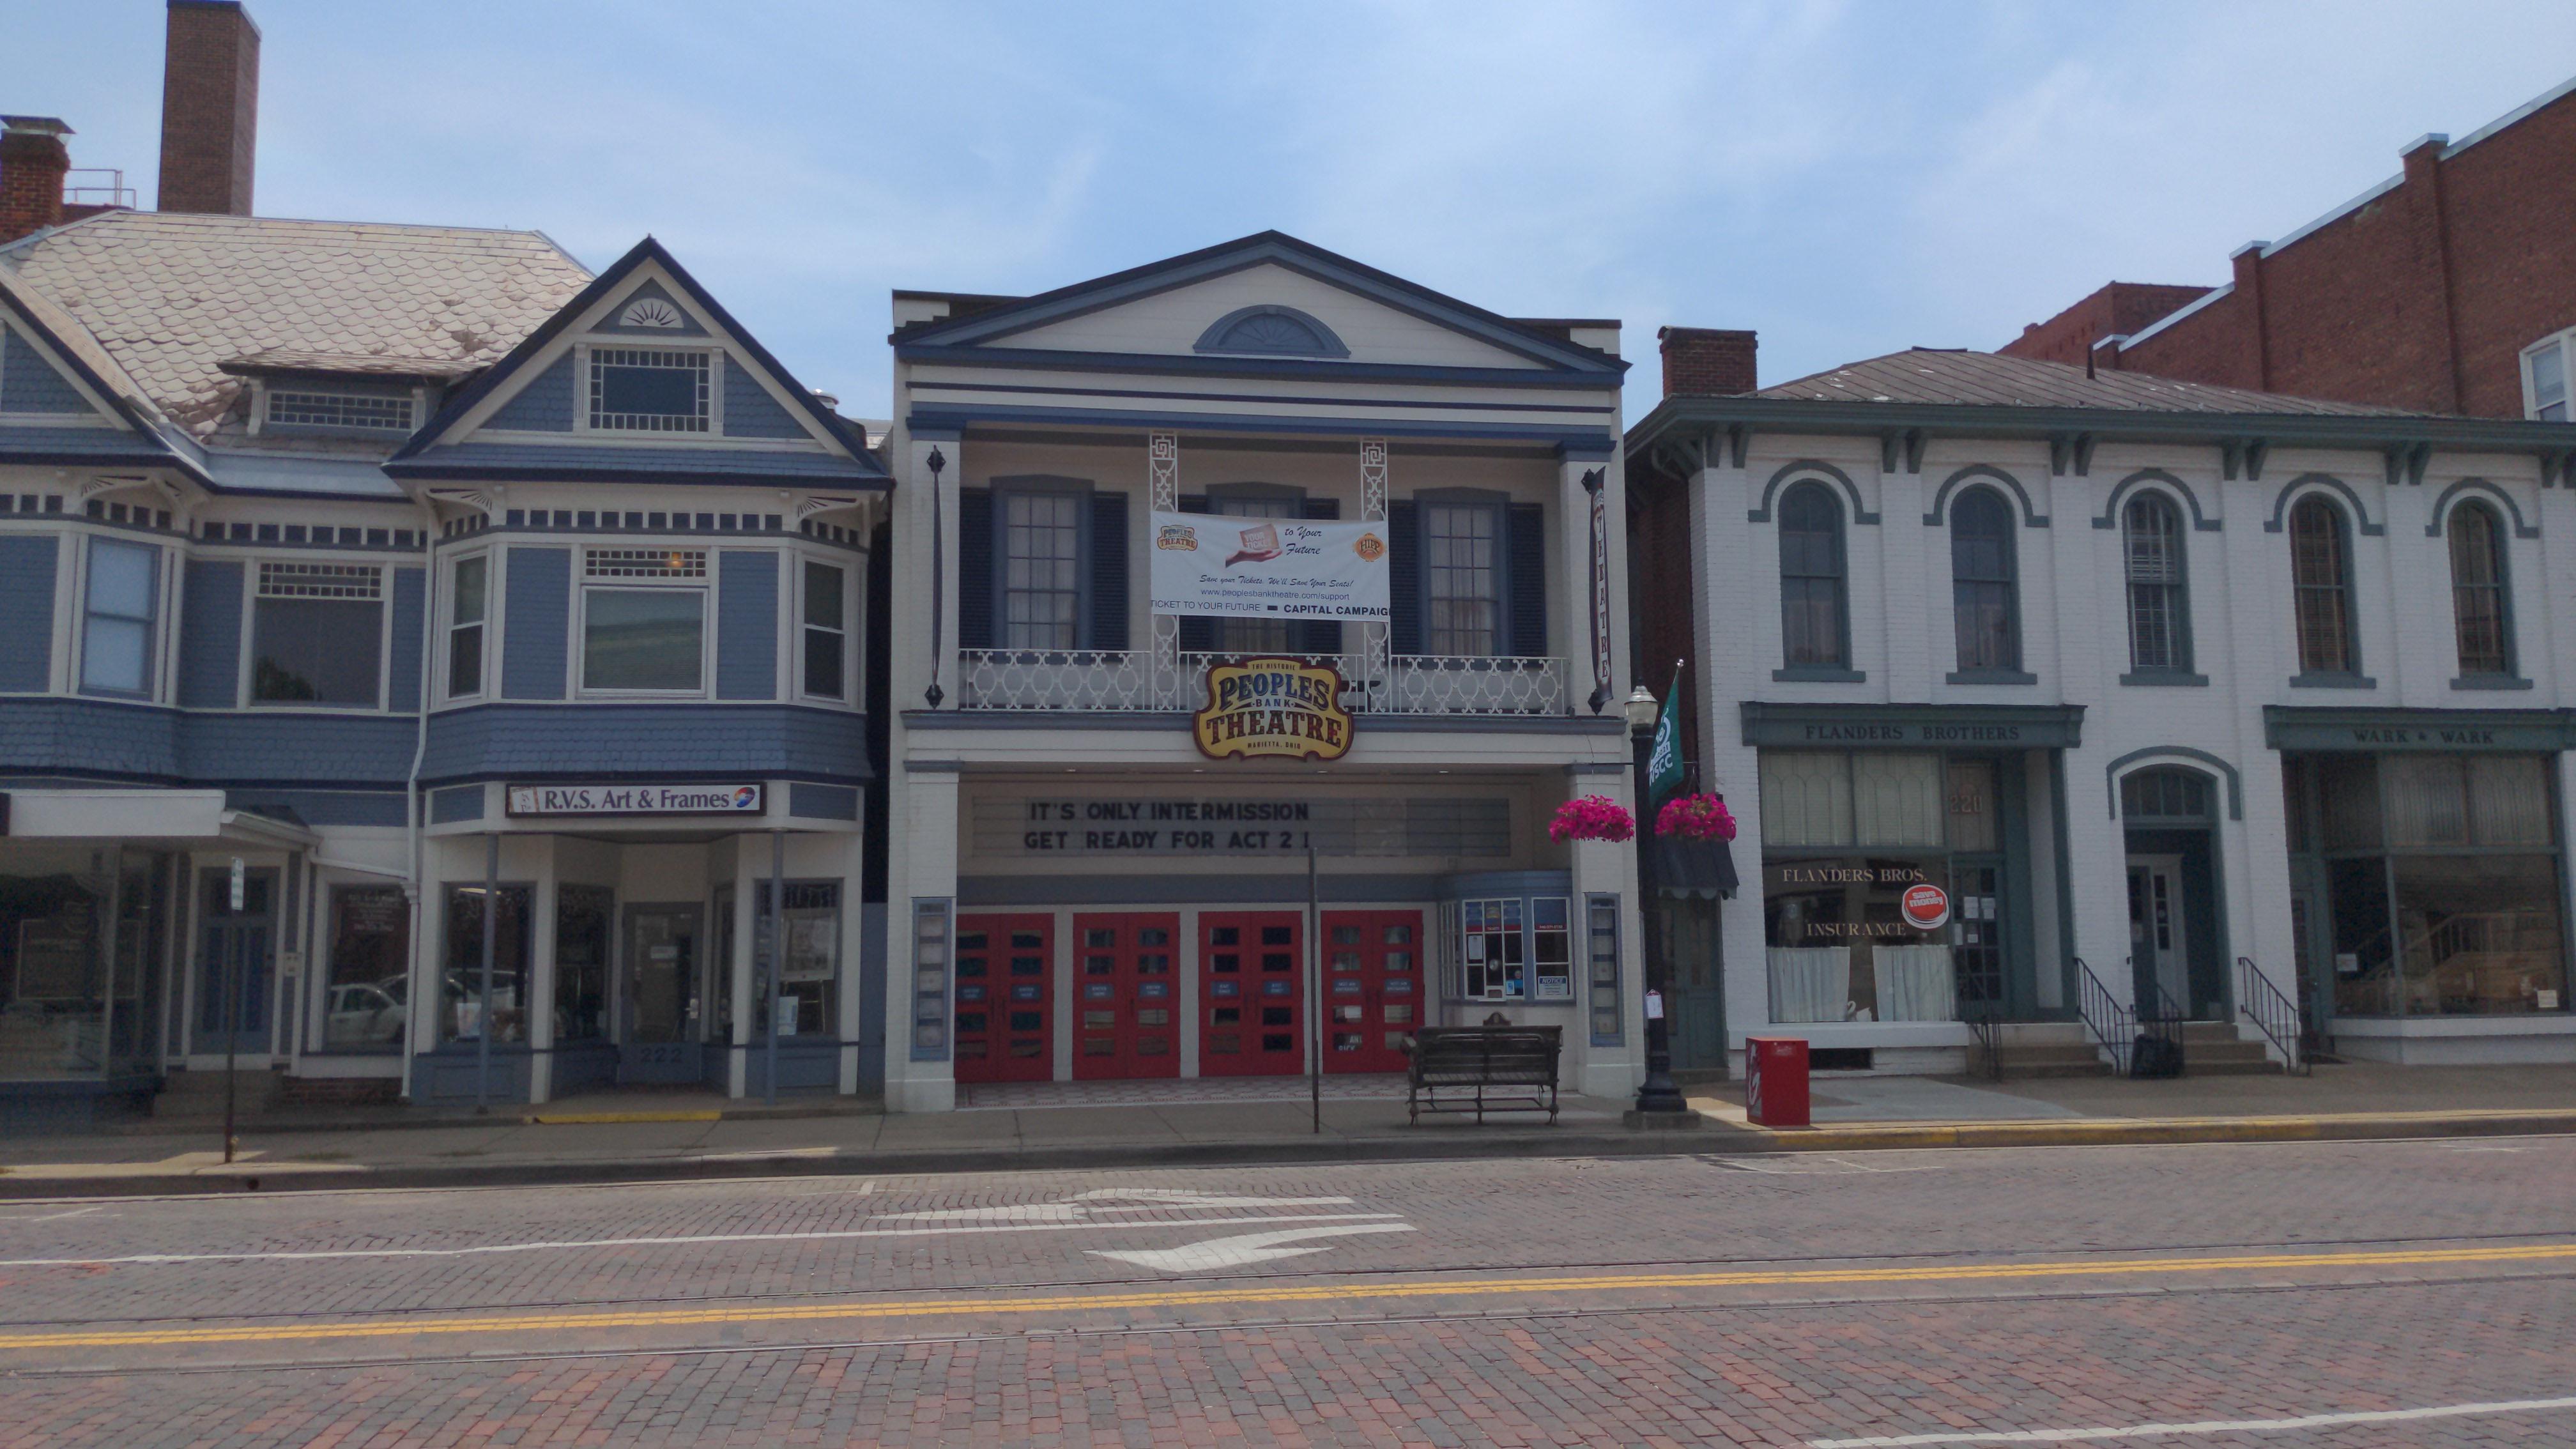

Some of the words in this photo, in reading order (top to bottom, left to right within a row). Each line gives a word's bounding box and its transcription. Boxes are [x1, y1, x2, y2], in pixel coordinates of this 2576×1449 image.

[1297, 526, 1322, 540] Your
[1286, 543, 1321, 555] Future
[1200, 574, 1218, 583] Save
[1310, 578, 1326, 588] Your
[1201, 589, 1350, 602] www.peoplesbanktheatre.com/support
[1151, 599, 1181, 608] TICKET
[1184, 601, 1195, 610] TO
[1198, 601, 1223, 611] YOUR
[1225, 602, 1261, 611] FUTURE
[1284, 604, 1333, 615] CAPITAL
[1336, 606, 1390, 617] CAMPAIG
[1218, 673, 1330, 711] PEOPLES
[1255, 699, 1291, 708] BANK
[1206, 710, 1342, 748] THEATRE
[1805, 726, 1903, 740] FLANDERS
[1923, 726, 2019, 740] BROTHERS
[2353, 730, 2409, 743] WARK
[2440, 730, 2494, 744] WARK
[545, 790, 595, 809] R.V.S.
[602, 790, 632, 809] Art
[638, 789, 654, 808] &
[661, 789, 730, 808] Frames
[1031, 802, 1075, 820] IT'S
[1087, 802, 1142, 820] ONLY
[1151, 802, 1309, 821] INTERMISSION
[1024, 831, 1068, 850] GET
[1086, 831, 1158, 849] READY
[1172, 831, 1214, 849] FOR
[1229, 831, 1268, 848] ACT
[1783, 868, 1874, 882] FLANDERS
[1881, 868, 1928, 882] BROS.
[1807, 923, 1906, 937] INSURANCE
[641, 1046, 684, 1064] 222
